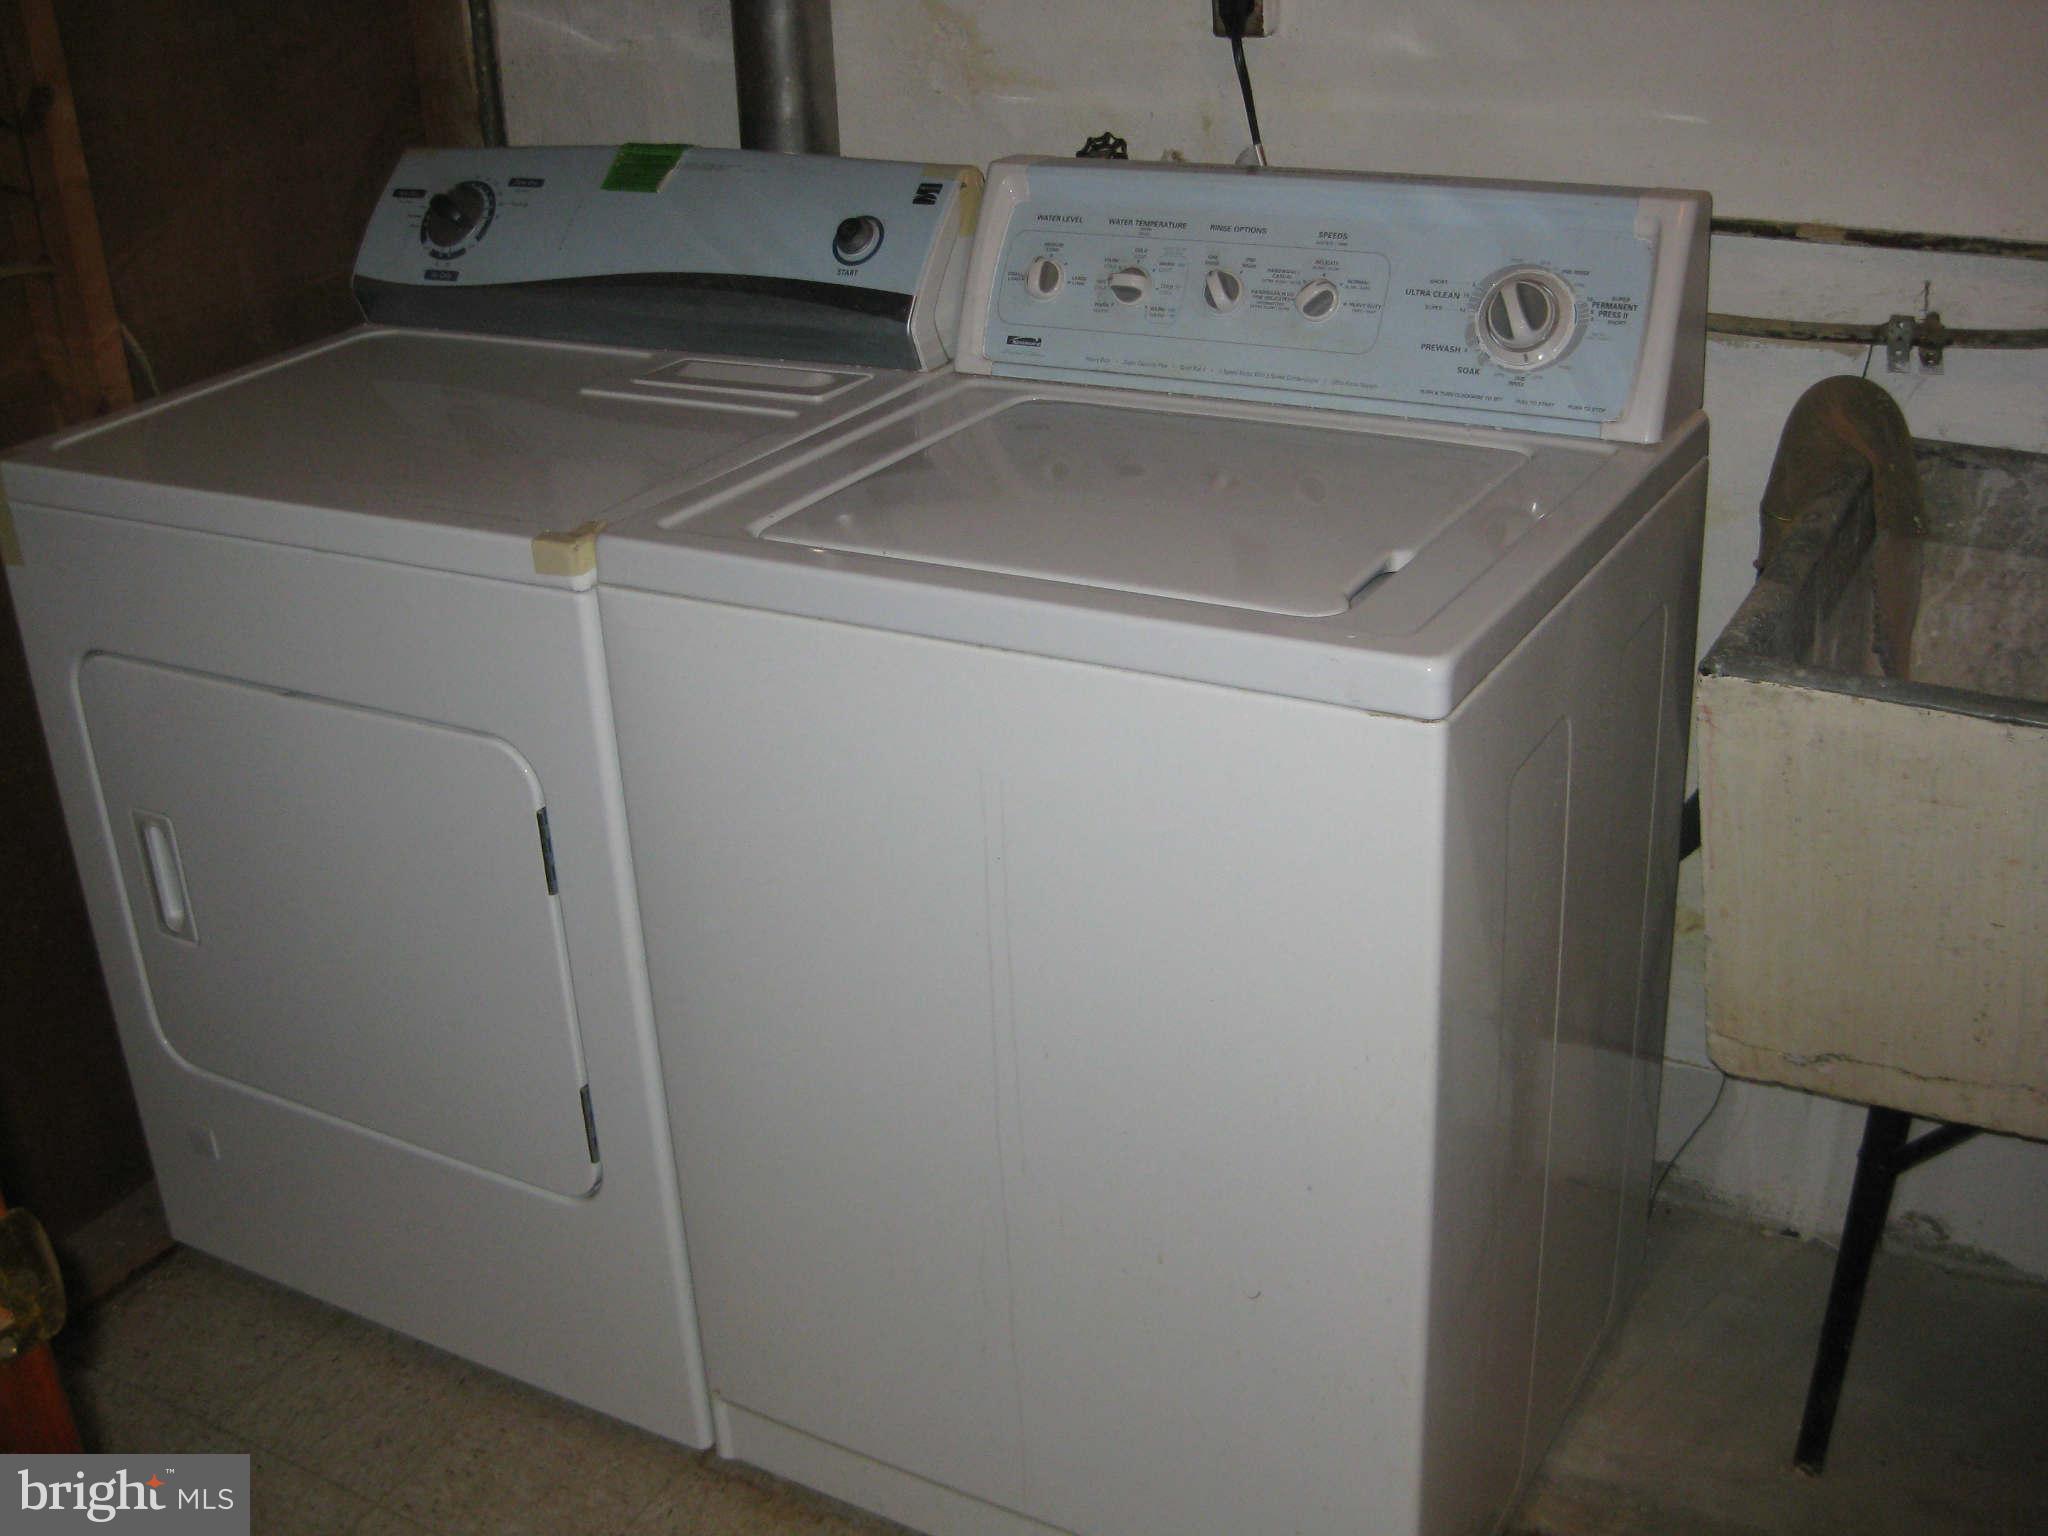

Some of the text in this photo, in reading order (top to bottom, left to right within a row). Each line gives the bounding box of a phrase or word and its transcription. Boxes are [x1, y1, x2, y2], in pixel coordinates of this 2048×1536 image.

[1037, 214, 1084, 224] WATER LEVEL
[1108, 218, 1187, 230] WATER TEMPERATURE
[1209, 224, 1268, 235] RINSE OPTIONS
[1318, 231, 1348, 240] SPEEDS
[835, 268, 859, 278] START
[1405, 288, 1431, 297] ULTRA
[1433, 290, 1460, 299] CLEAN
[1592, 301, 1638, 311] PERMANENT
[1598, 310, 1622, 319] PRESS
[1420, 343, 1461, 353] PREWASH
[1457, 366, 1481, 376] SOAK
